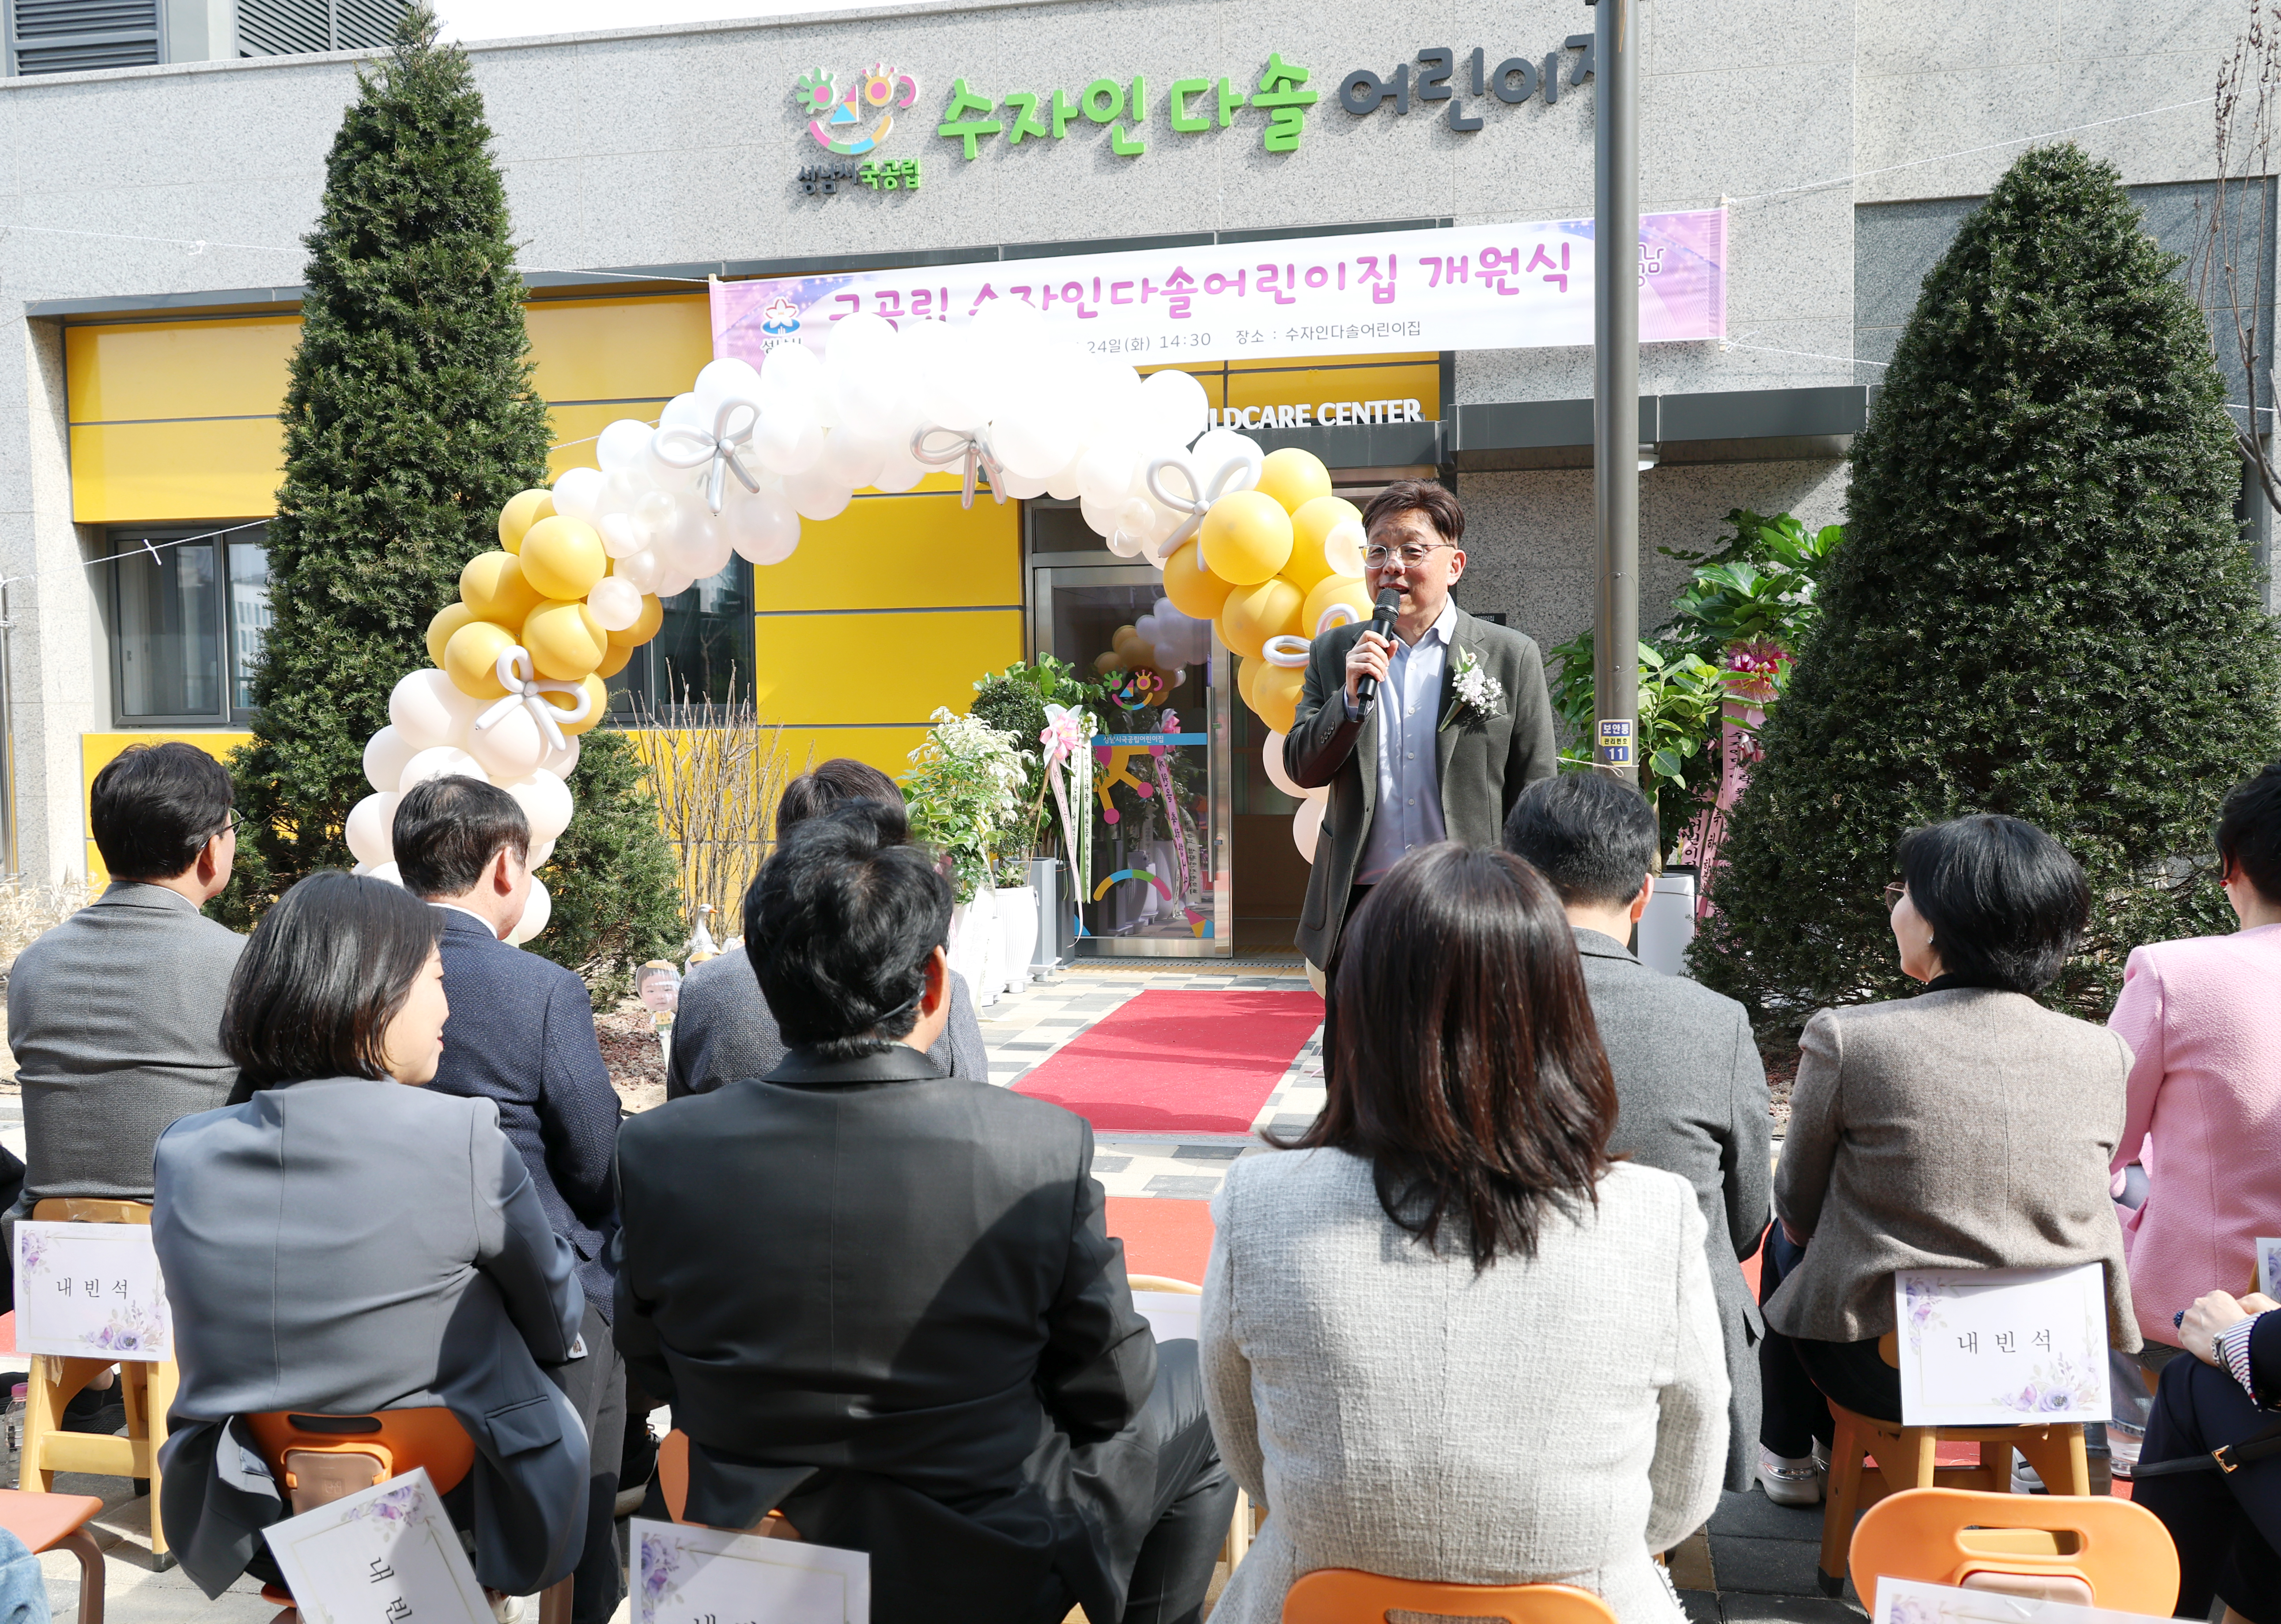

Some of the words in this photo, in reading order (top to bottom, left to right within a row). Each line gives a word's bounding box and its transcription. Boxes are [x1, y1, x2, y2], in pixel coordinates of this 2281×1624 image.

[938, 75, 1145, 160] 수자인
[1171, 52, 1318, 153] 다솔
[1419, 242, 1570, 295] 개원식
[1087, 336, 1150, 353] 24일(화)
[1159, 333, 1211, 348] 14:30
[1236, 329, 1264, 344] 장소
[1285, 321, 1420, 341] 수자인다솔어린이집
[1204, 404, 1311, 431] LDCARE
[1317, 398, 1423, 427] CENTER
[1103, 735, 1164, 744] 성남시국공립어린이집
[1603, 724, 1629, 734] 보안등
[1609, 748, 1623, 759] 11
[1703, 812, 1722, 877] 축하합
